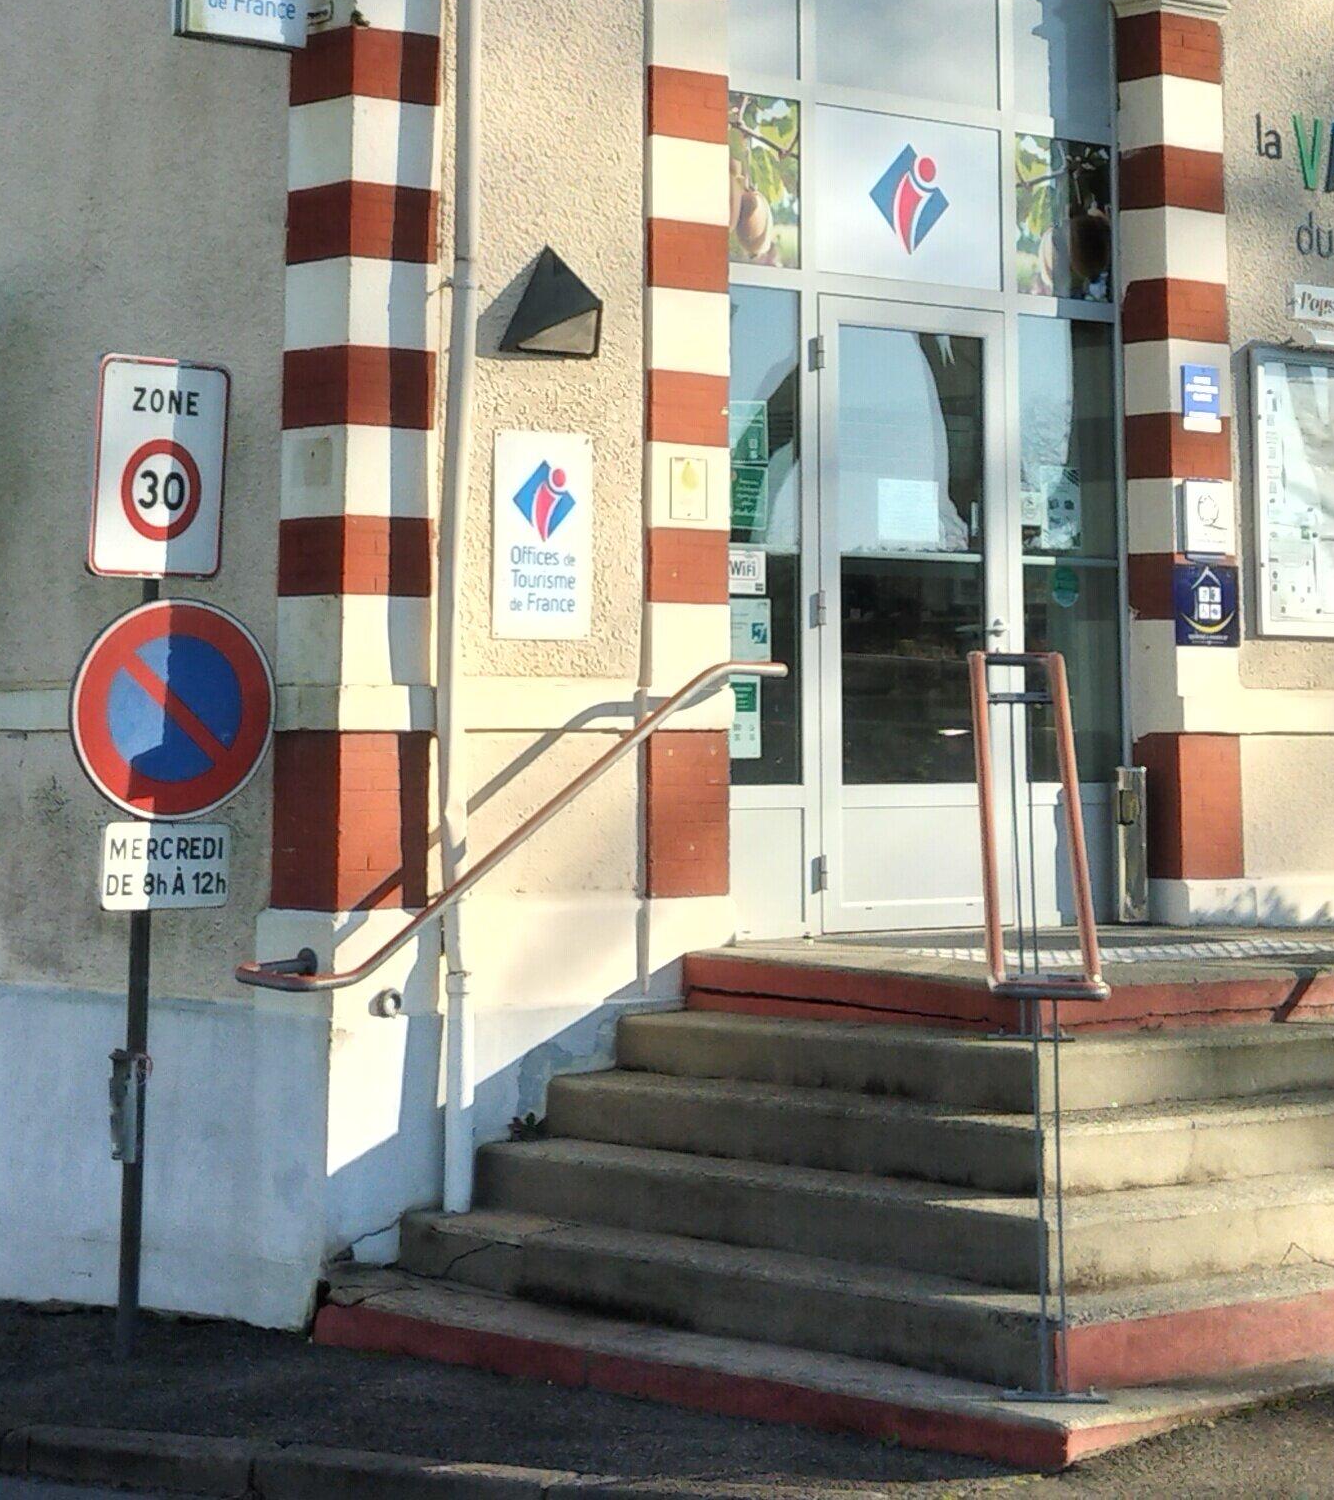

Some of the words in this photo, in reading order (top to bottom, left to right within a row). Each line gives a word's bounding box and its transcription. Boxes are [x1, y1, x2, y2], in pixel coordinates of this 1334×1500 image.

[1255, 113, 1283, 160] la
[1296, 211, 1334, 258] du
[132, 386, 201, 417] ZONE
[137, 469, 185, 511] 30
[510, 545, 560, 566] Offices
[563, 552, 576, 567] de
[510, 568, 576, 590] Tourisme
[509, 597, 523, 612] de
[527, 592, 576, 613] France
[109, 837, 224, 861] MERCREDI
[106, 874, 133, 896] DE
[143, 872, 167, 896] 8h
[192, 872, 227, 895] 12h
